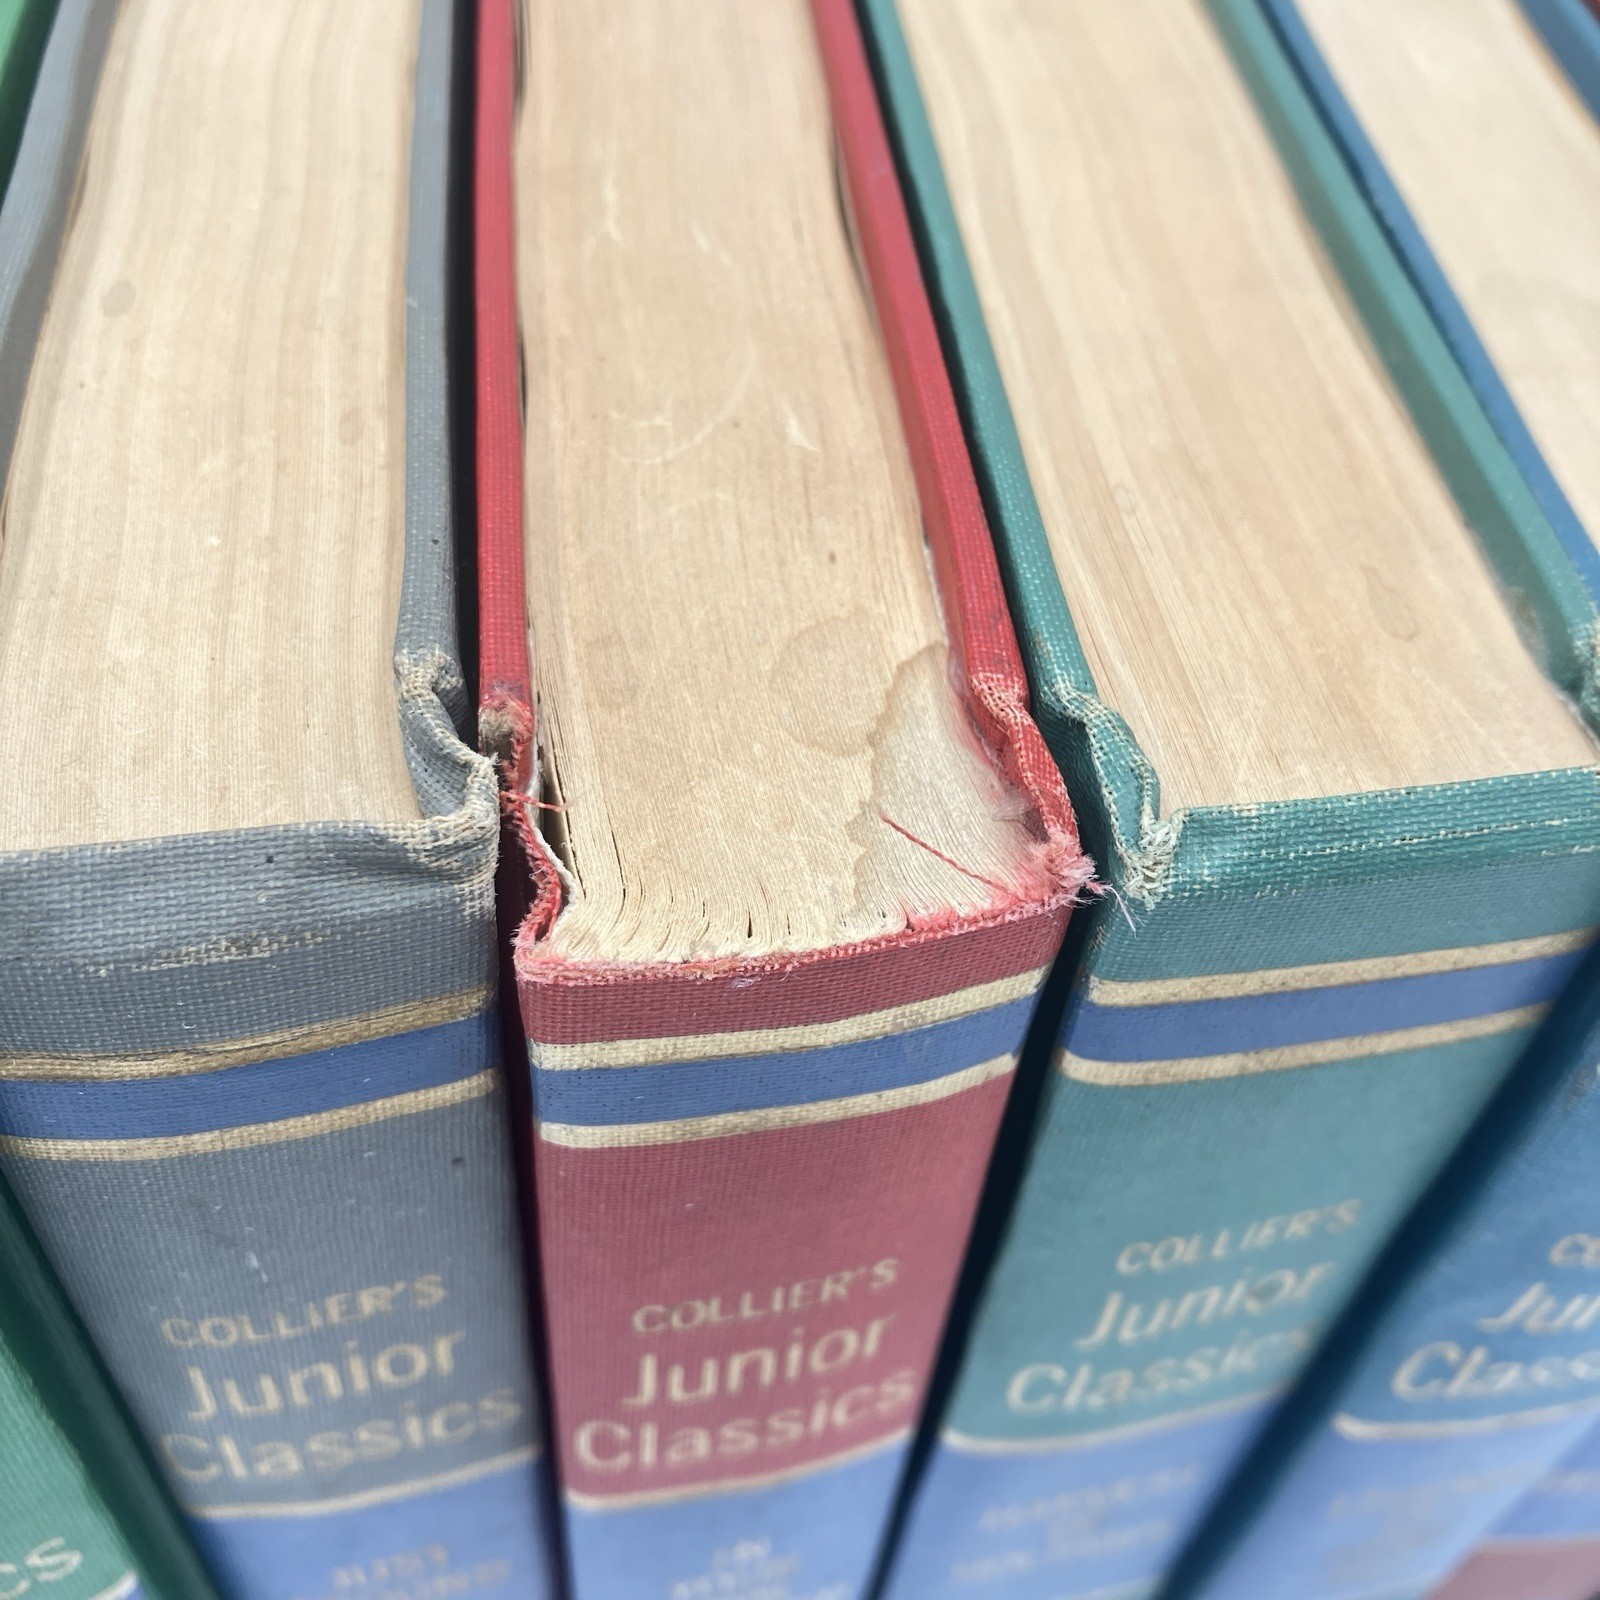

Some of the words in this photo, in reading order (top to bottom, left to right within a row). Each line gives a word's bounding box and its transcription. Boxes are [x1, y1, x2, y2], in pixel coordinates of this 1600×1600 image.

[161, 1272, 446, 1349] COLLIER'S
[631, 1258, 899, 1333] COLLIER'S
[1074, 1260, 1336, 1351] Junior
[187, 1329, 464, 1421] Junior
[623, 1313, 897, 1408] Junior
[160, 1388, 522, 1484] Classics
[573, 1370, 914, 1474] Classics
